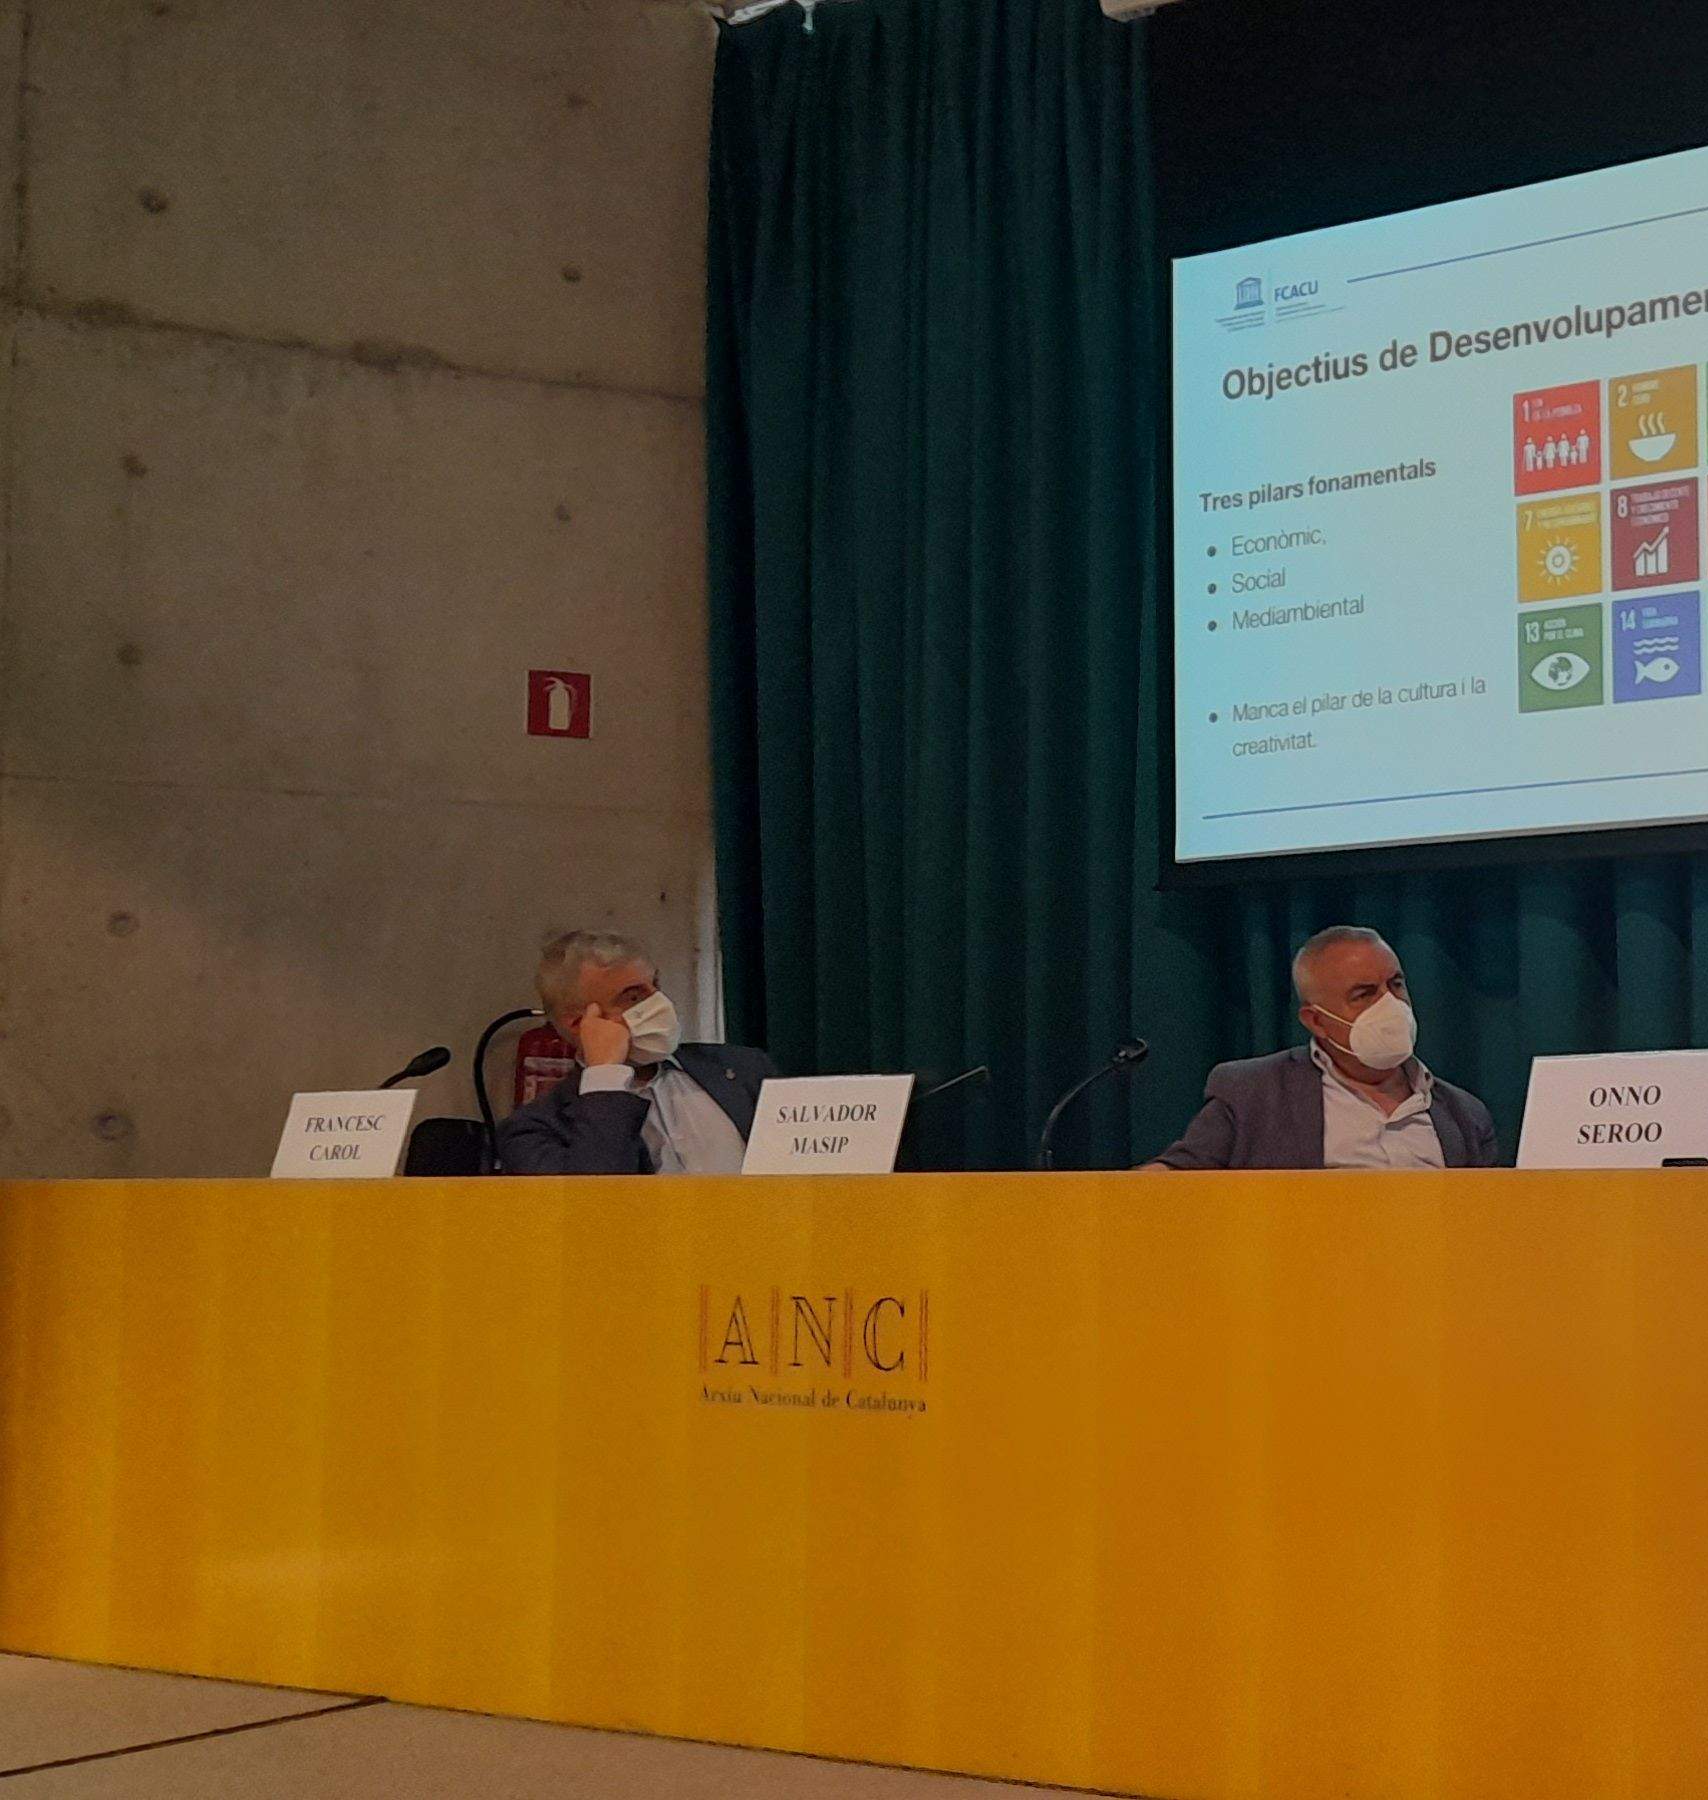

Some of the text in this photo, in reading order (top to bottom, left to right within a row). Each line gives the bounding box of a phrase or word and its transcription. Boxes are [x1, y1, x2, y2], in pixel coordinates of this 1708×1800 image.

[1274, 280, 1319, 302] FCACU
[1222, 352, 1368, 400] Objectius
[1379, 339, 1418, 372] de
[1618, 384, 1628, 408] 2
[1522, 400, 1530, 421] 1
[1200, 458, 1437, 512] Tres pilars fonamentals
[1617, 495, 1628, 518] 8
[1523, 511, 1533, 532] 7
[1231, 567, 1286, 593] Social
[1232, 595, 1365, 630] Mediambiental
[1620, 609, 1636, 631] 14
[1525, 621, 1540, 643] 13
[1232, 702, 1289, 722] Manca
[1292, 697, 1306, 715] el
[1312, 693, 1347, 716] pilar
[1351, 689, 1374, 708] de
[1378, 686, 1393, 704] la
[1397, 682, 1457, 703] cultura
[1471, 675, 1486, 694] la
[1589, 1085, 1661, 1108] ONNO
[304, 1115, 386, 1133] FRANCESC
[776, 1104, 878, 1124] SALVADOR
[1577, 1122, 1662, 1145] SEROO
[309, 1144, 362, 1161] CAROL
[790, 1136, 849, 1155] MASIP
